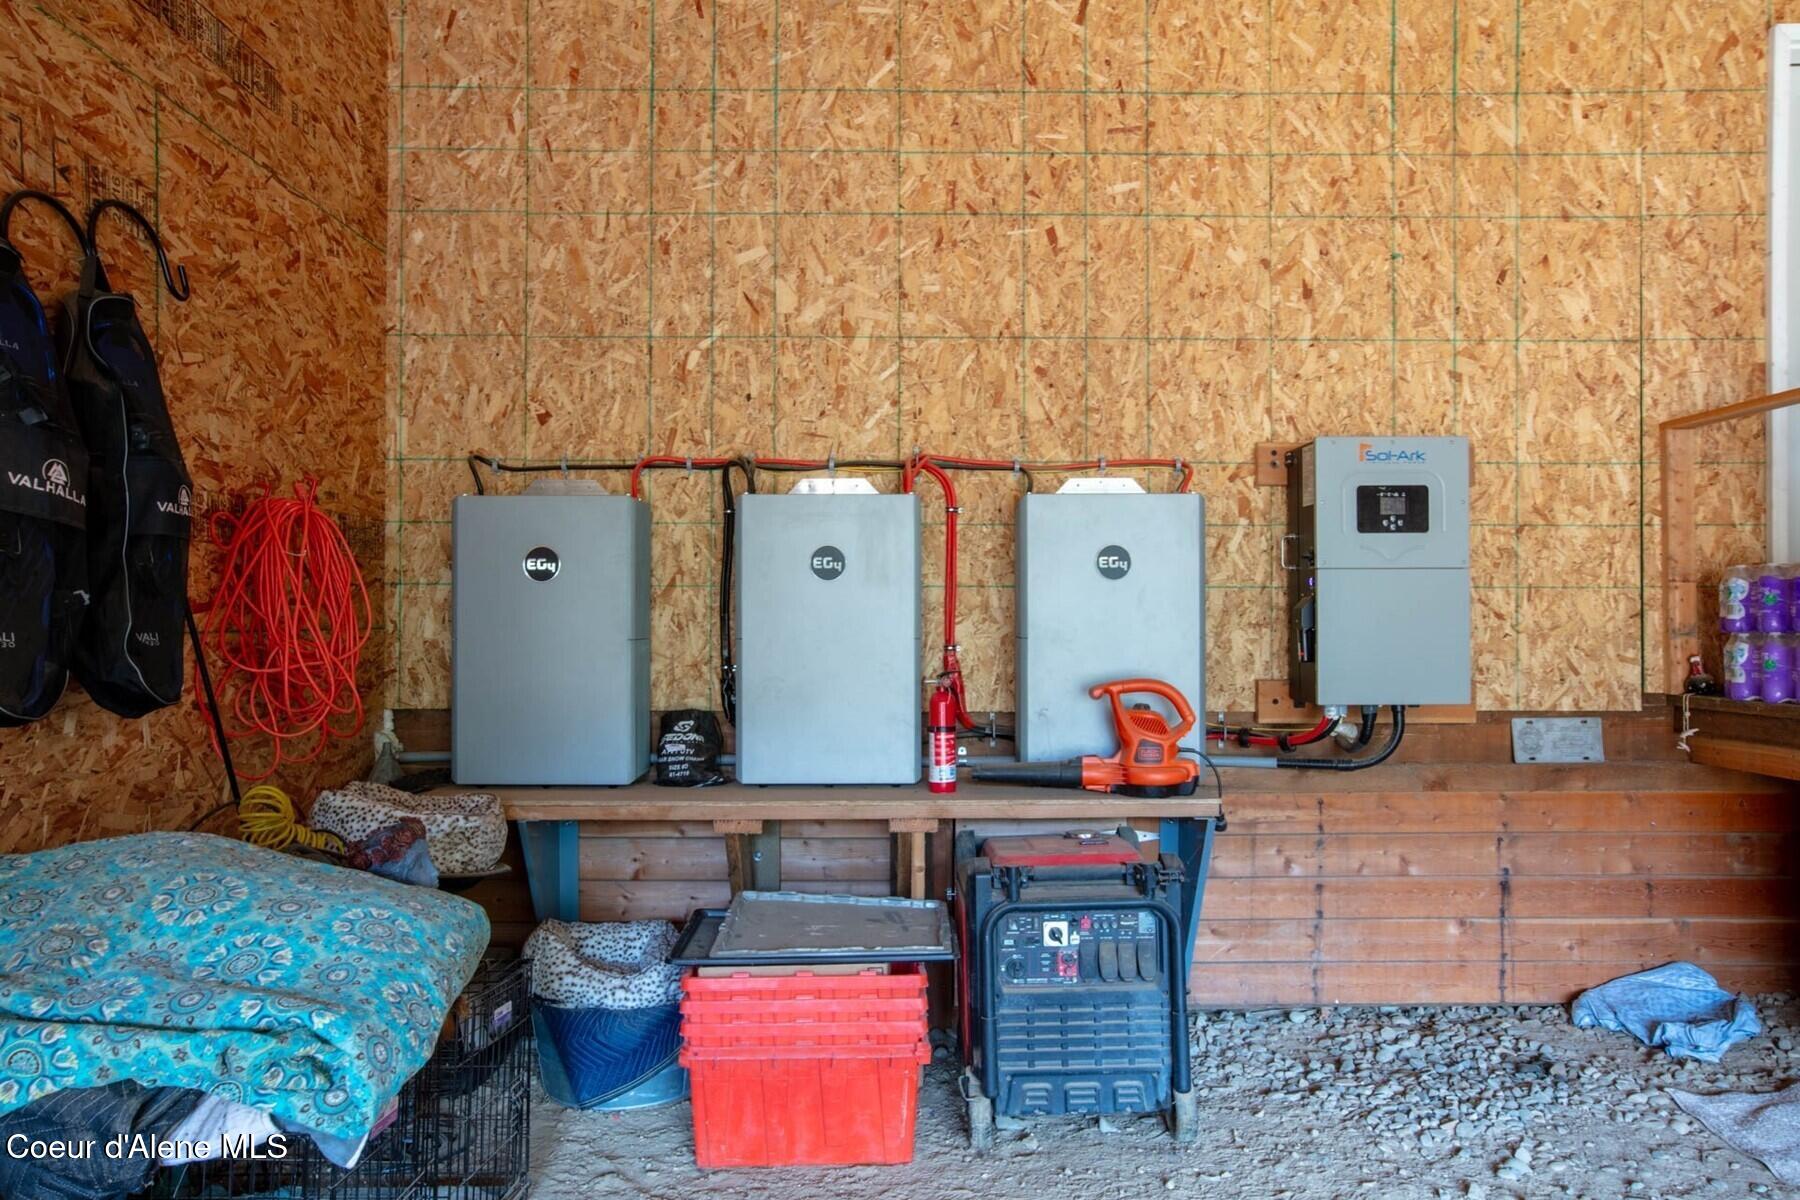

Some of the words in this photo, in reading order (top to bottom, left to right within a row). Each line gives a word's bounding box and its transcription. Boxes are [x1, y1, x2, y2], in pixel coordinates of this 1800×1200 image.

[1365, 450, 1425, 461] Sol-Ark
[8, 471, 86, 507] VALHALLA
[136, 632, 159, 642] VALI
